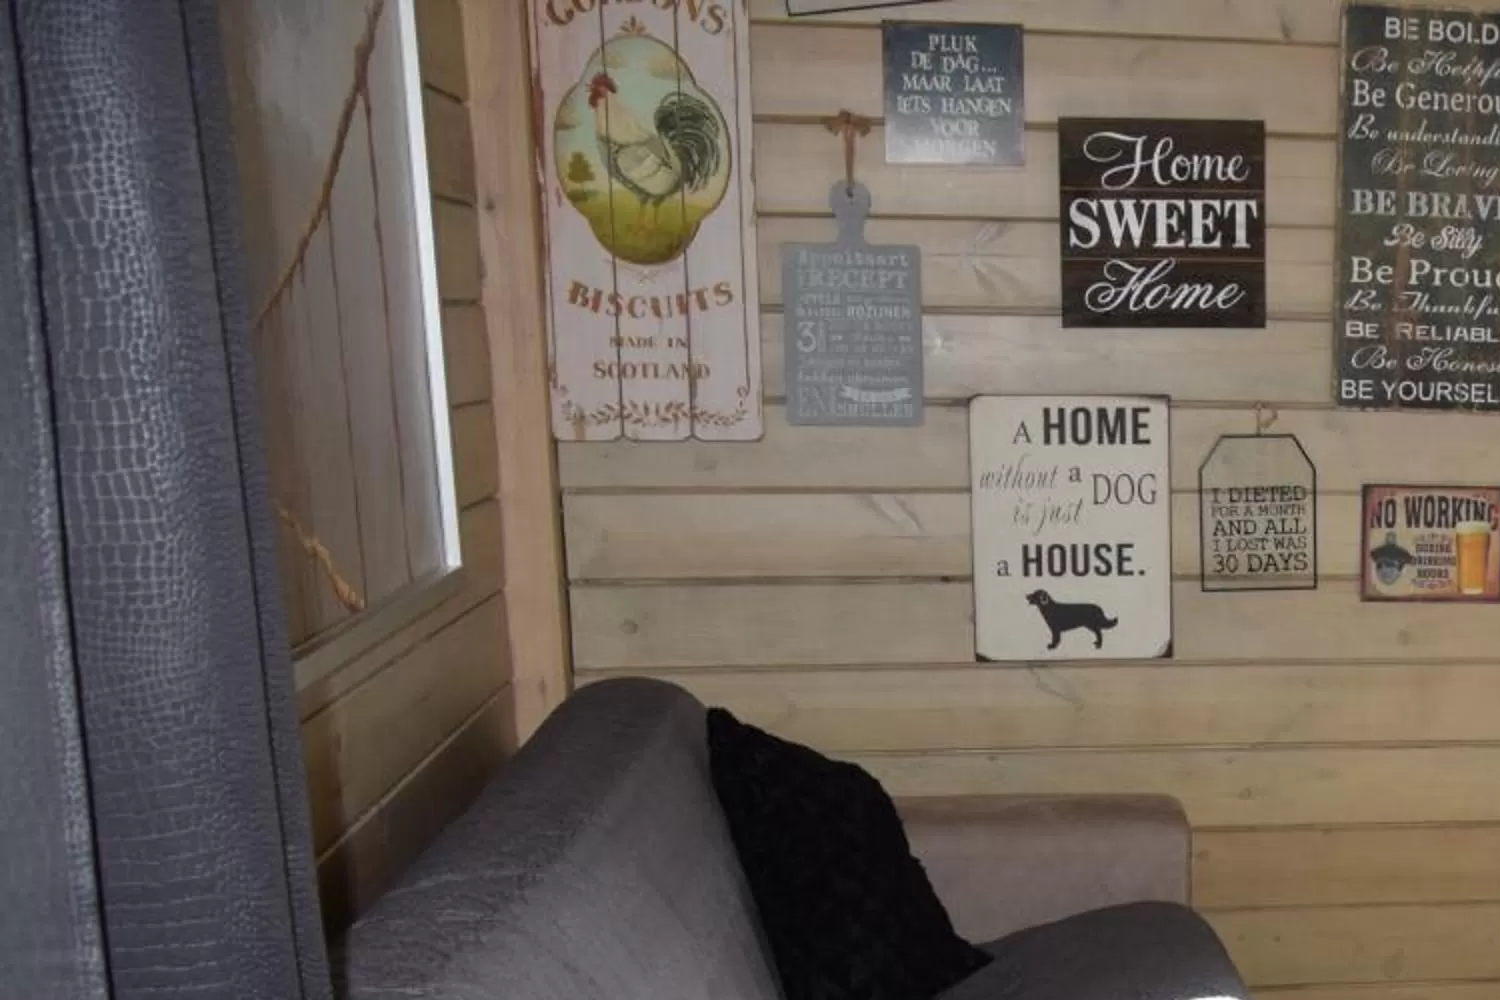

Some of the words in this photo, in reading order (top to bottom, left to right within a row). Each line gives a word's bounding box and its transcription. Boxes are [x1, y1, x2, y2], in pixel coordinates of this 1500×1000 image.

[929, 34, 977, 52] PLUK
[1385, 16, 1421, 40] BE
[1428, 19, 1500, 45] BOLD
[911, 51, 932, 70] DE
[1351, 46, 1400, 72] Be
[902, 73, 953, 92] MAAR
[964, 75, 1005, 93] LAAT
[1352, 79, 1386, 107] Be
[897, 96, 931, 115] IETS
[941, 98, 1012, 117] HANGEN
[931, 117, 980, 136] VOOR
[1348, 113, 1379, 139] Be
[1083, 131, 1248, 190] Home
[1371, 147, 1415, 176] Be
[1421, 149, 1499, 187] Loving
[1351, 188, 1396, 216] BE
[1069, 198, 1258, 249] SWEET
[1384, 223, 1425, 247] Be
[1430, 225, 1483, 260] Silly
[1351, 256, 1393, 284] Be
[1085, 257, 1246, 312] Home
[568, 280, 733, 318] BISCUITS
[1344, 289, 1382, 311] Be
[1345, 320, 1380, 338] BE
[610, 336, 654, 349] MADE
[667, 336, 688, 348] IN
[593, 360, 711, 380] SCOTLAND
[1352, 346, 1397, 369] Be
[1341, 379, 1374, 400] BE
[1013, 420, 1032, 444] A
[1043, 407, 1151, 445] HOME
[980, 453, 1059, 489] without
[1068, 465, 1083, 483] a
[1092, 473, 1157, 505] DOG
[1211, 487, 1221, 503] I
[1228, 486, 1308, 503] DIETED
[1013, 500, 1032, 526] is
[1034, 497, 1083, 536] just
[1211, 506, 1240, 517] FOR
[1243, 506, 1254, 517] A
[1258, 504, 1306, 517] MONTH
[1370, 498, 1397, 528] NO
[1404, 495, 1500, 531] WORKING
[1213, 519, 1257, 536] AND
[1264, 517, 1307, 535] ALL
[1212, 539, 1221, 552] I
[1227, 538, 1270, 553] LOST
[1272, 536, 1307, 550] WAS
[996, 559, 1012, 577] a
[1022, 544, 1146, 577] HOUSE.
[1212, 554, 1239, 573] 30
[1247, 552, 1309, 573] DAYS
